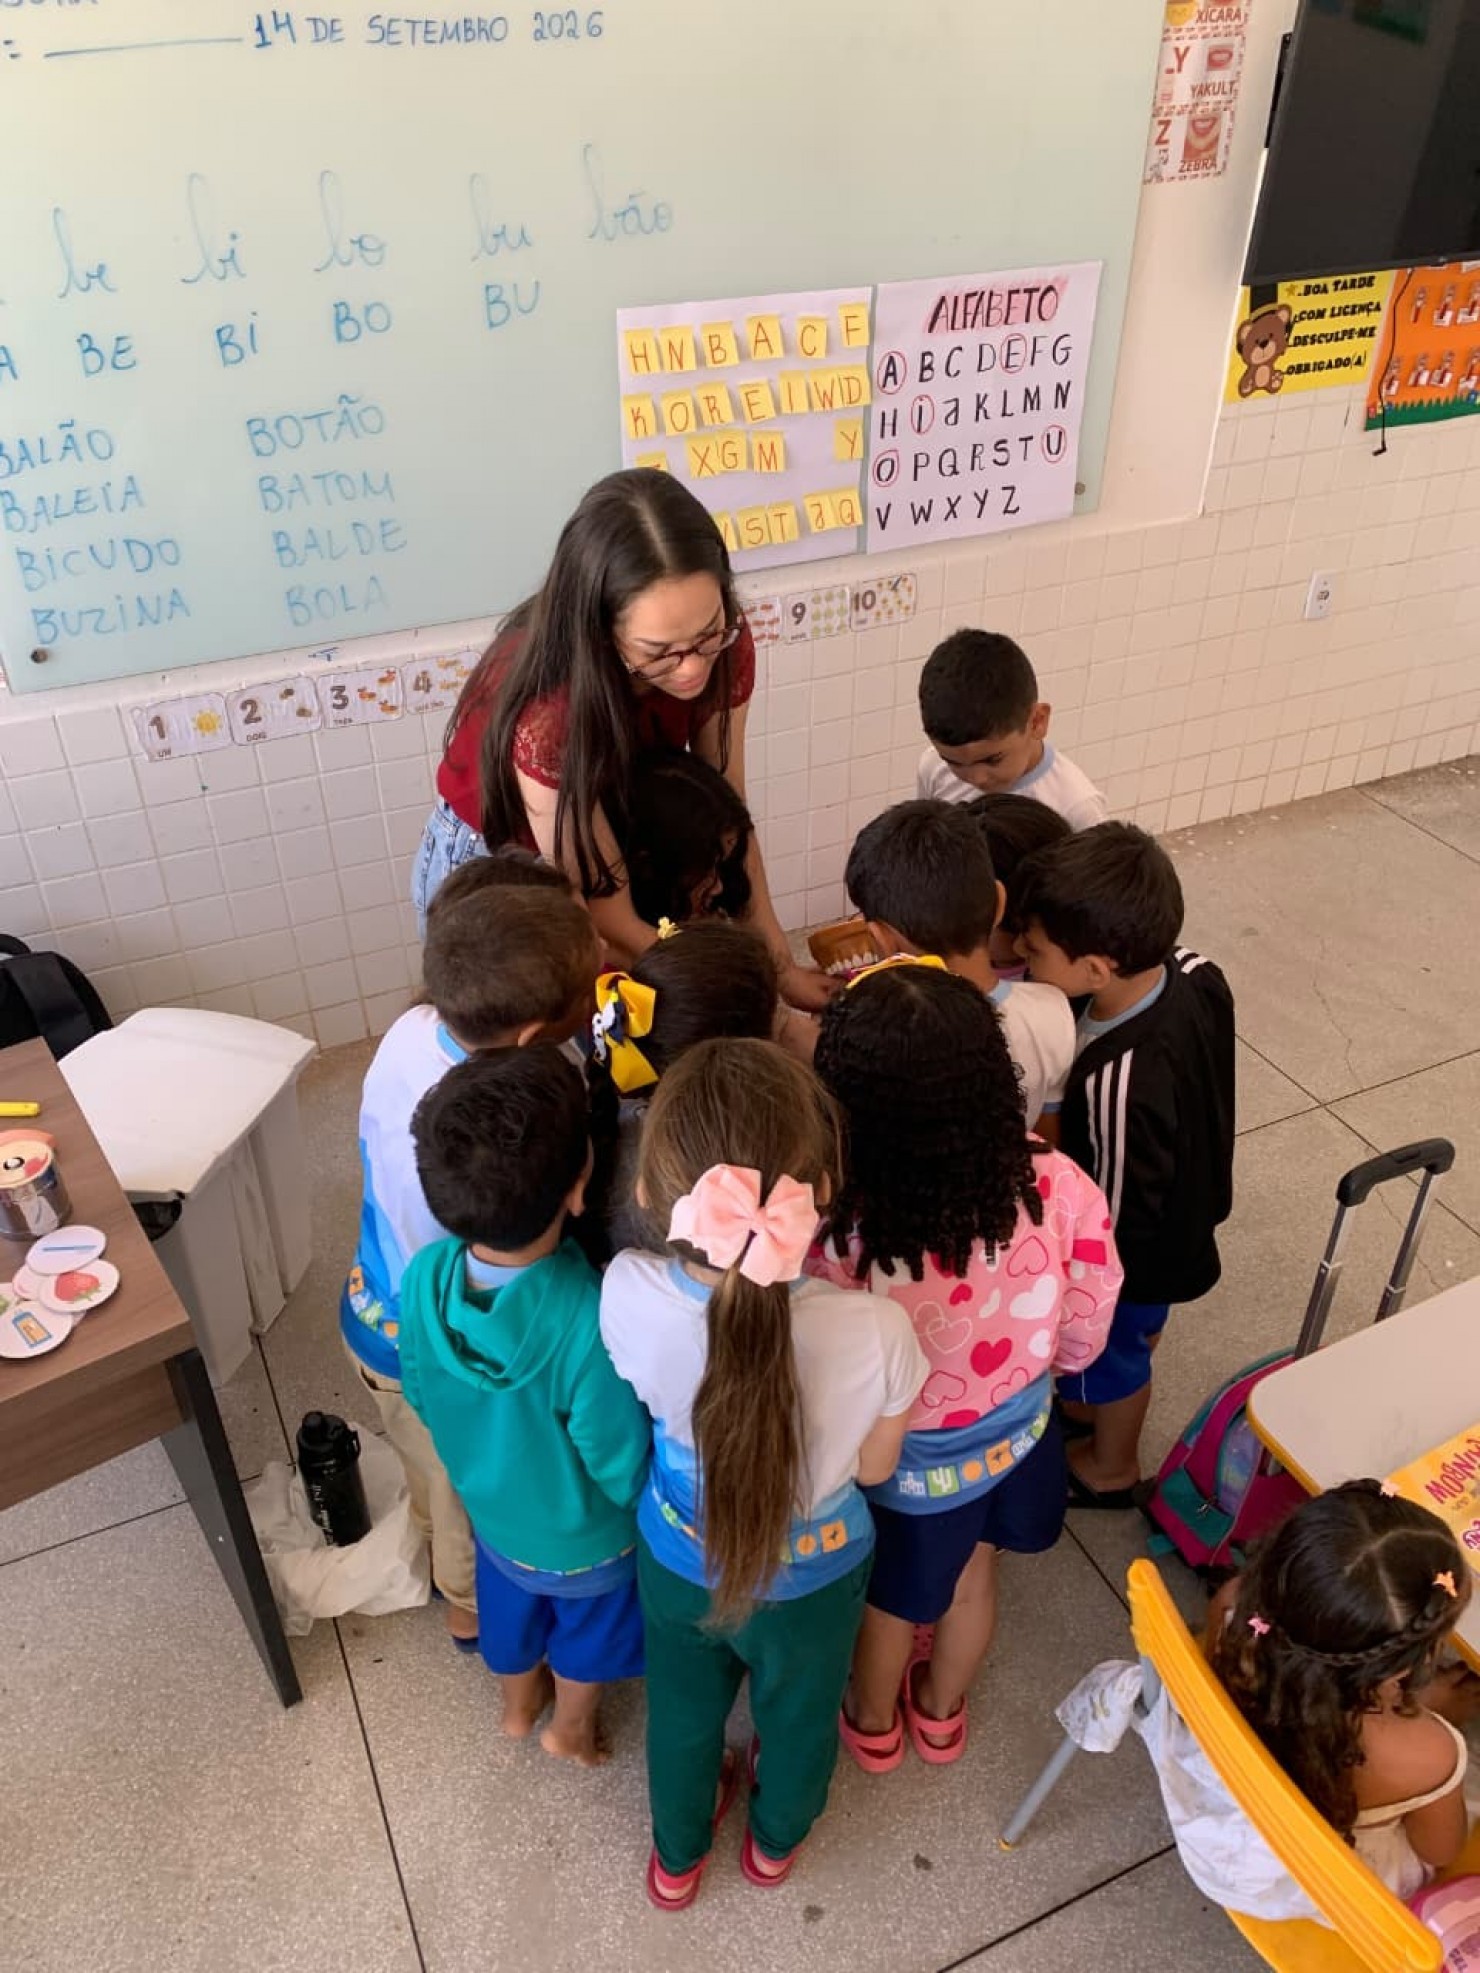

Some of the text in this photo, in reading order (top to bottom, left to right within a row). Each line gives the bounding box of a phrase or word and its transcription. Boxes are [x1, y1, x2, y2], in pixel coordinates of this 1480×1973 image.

[255, 10, 604, 48] 14 DE SETEMBRO 2026
[1190, 81, 1236, 98] YAKULT
[1155, 119, 1172, 146] Z
[1178, 158, 1217, 173] ZEBRA
[313, 169, 388, 272] bo
[469, 172, 533, 263] bu
[1332, 276, 1376, 291] TARDE
[76, 332, 137, 378] BE
[333, 301, 391, 343] BO
[484, 281, 540, 329] BU
[927, 284, 1058, 334] ALFABETO
[1330, 301, 1382, 318] LICENÇA
[630, 315, 861, 373] H N B A C F
[882, 333, 1073, 388] A B C D E F G
[670, 401, 689, 432] O
[703, 395, 725, 424] R
[744, 390, 766, 421] E
[814, 378, 835, 409] W
[843, 376, 862, 405] D
[880, 408, 898, 439] H
[974, 393, 990, 423] K
[1001, 390, 1014, 417] L
[1022, 385, 1040, 413] M
[1054, 381, 1071, 409] N
[0, 394, 384, 479] BALÃO BOTÃO
[692, 430, 858, 476] X G M Y
[876, 430, 1063, 482] O P Q R S T U
[258, 470, 395, 513] BATOM
[876, 486, 1020, 530] V W X Y Z
[272, 518, 407, 568] BALDE
[745, 517, 764, 544] S
[774, 512, 787, 543] T
[286, 575, 389, 627] BOLA
[791, 602, 807, 625] 9
[853, 589, 877, 612] 10
[330, 685, 349, 710] 3
[413, 670, 432, 693] 4
[149, 715, 166, 739] 1
[240, 699, 262, 725] 2
